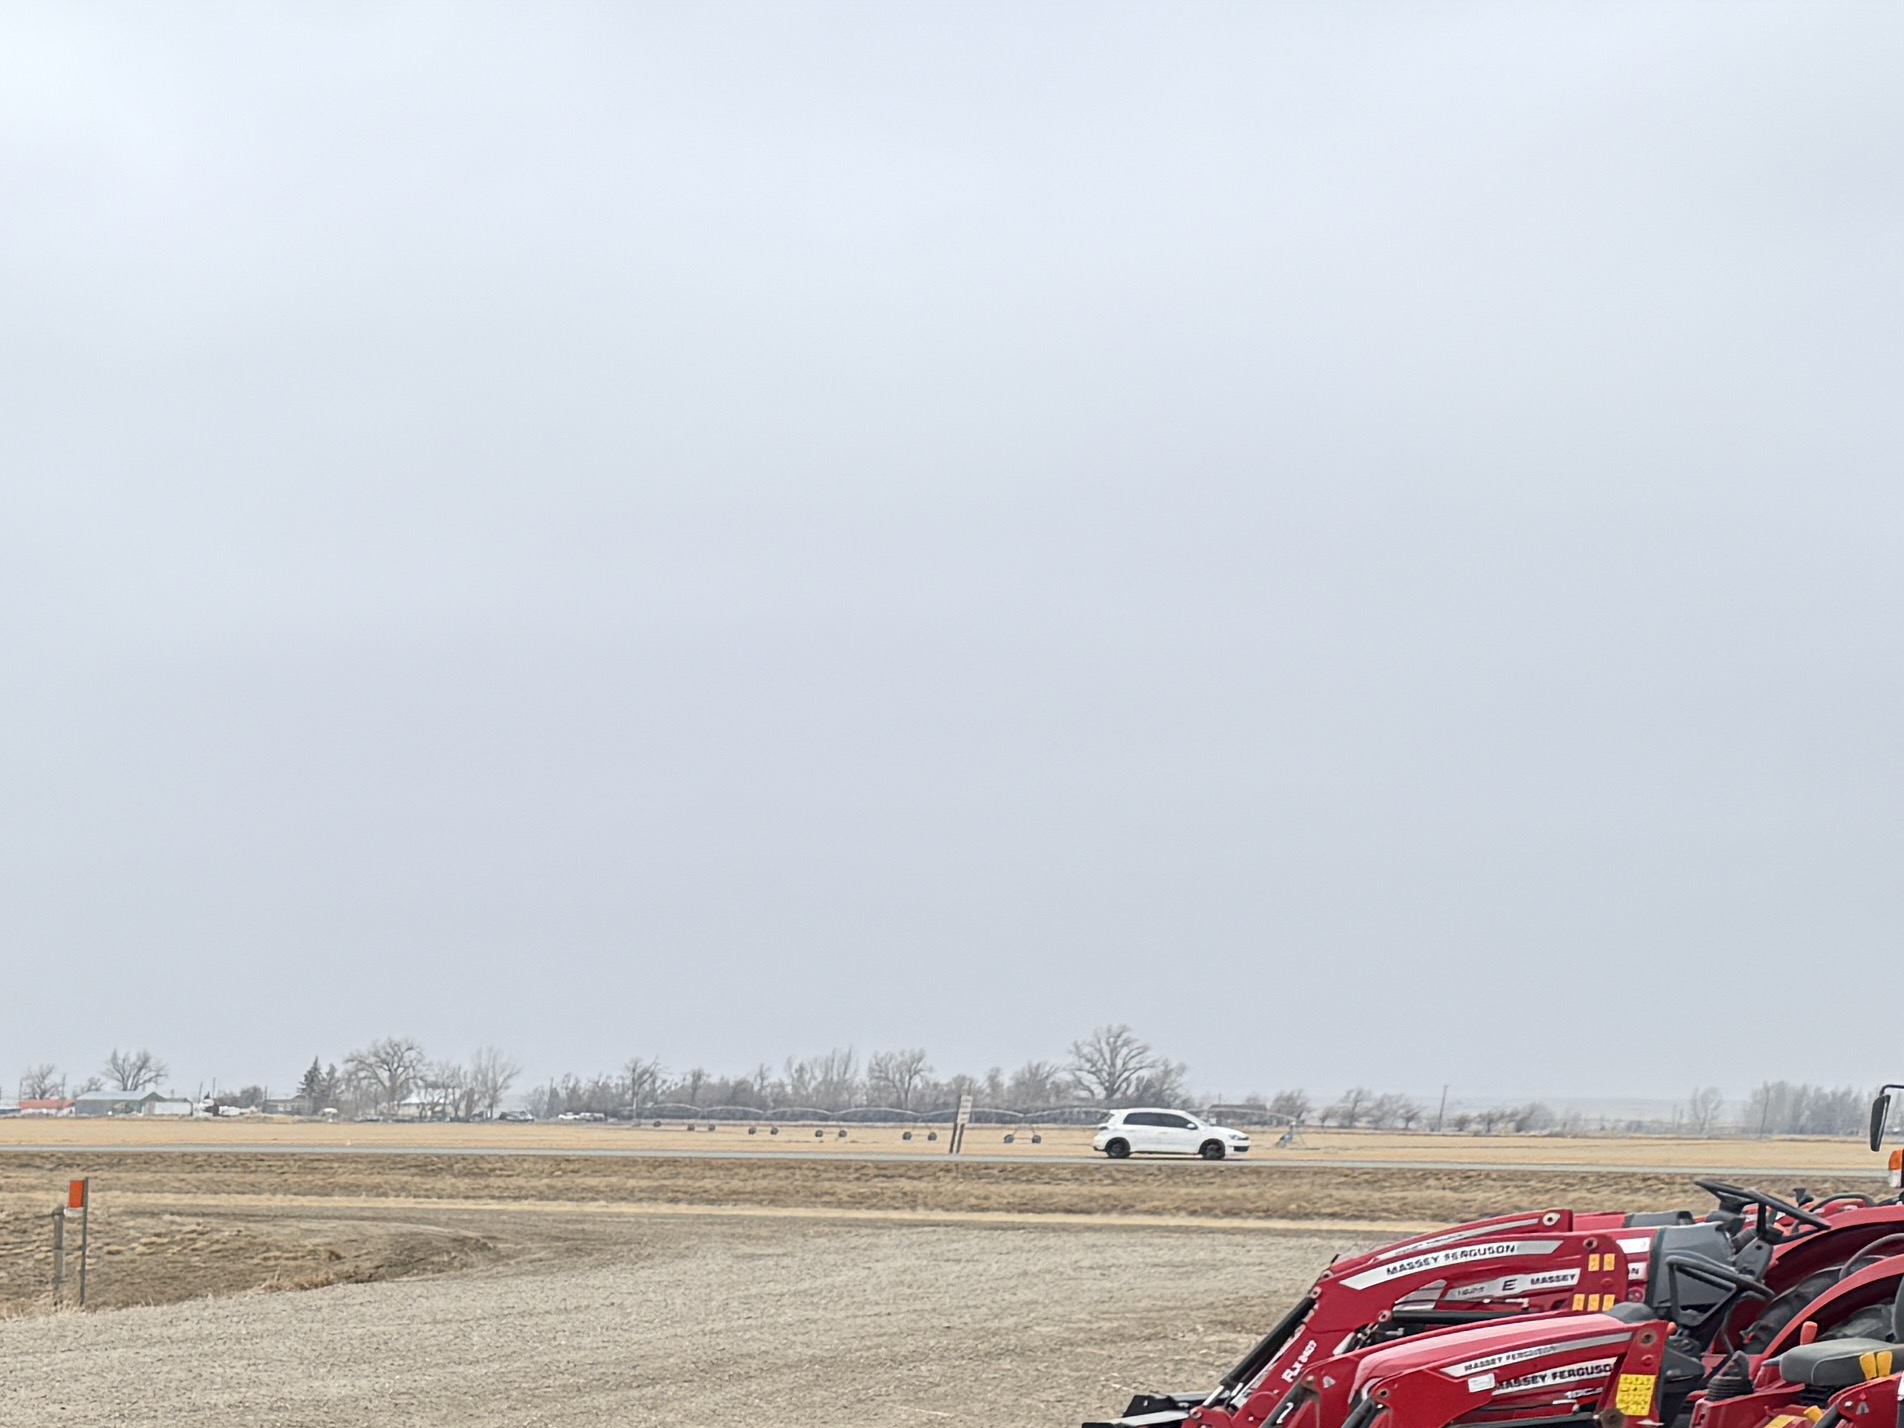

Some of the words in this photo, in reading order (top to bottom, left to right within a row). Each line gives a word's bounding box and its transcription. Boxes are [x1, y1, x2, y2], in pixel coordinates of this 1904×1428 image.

[1386, 1255, 1441, 1276] MASSEY
[1444, 1244, 1516, 1262] FERGUSON
[1502, 1278, 1517, 1292] E
[1530, 1272, 1577, 1286] MASSEY
[1552, 1363, 1614, 1382] FERGUSO
